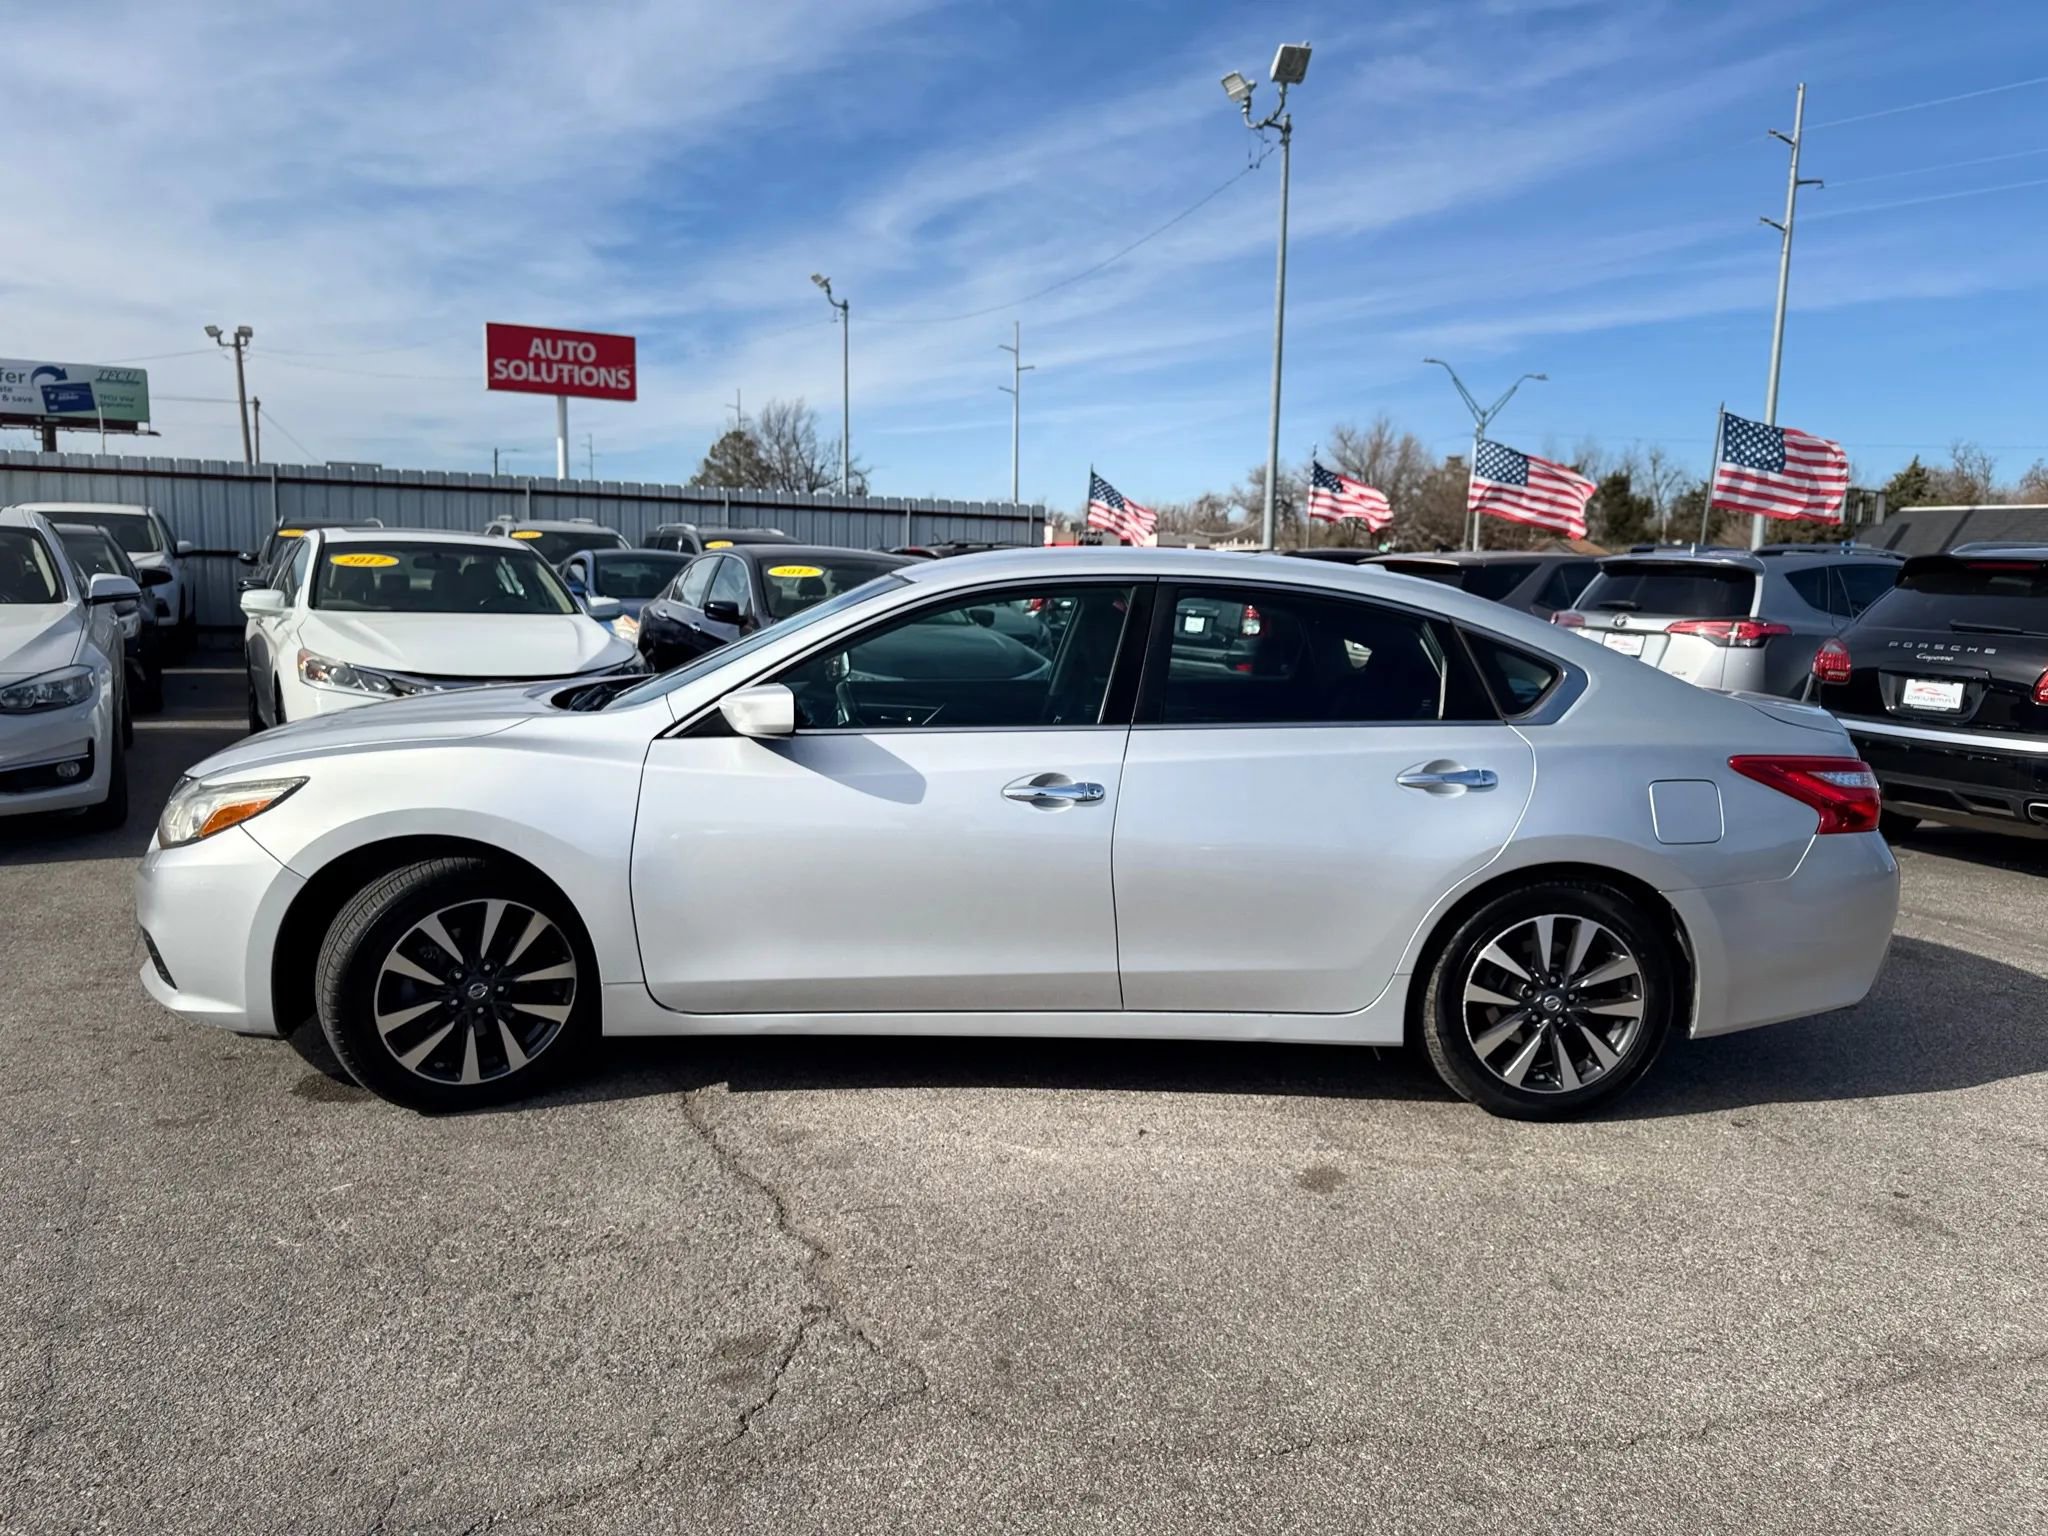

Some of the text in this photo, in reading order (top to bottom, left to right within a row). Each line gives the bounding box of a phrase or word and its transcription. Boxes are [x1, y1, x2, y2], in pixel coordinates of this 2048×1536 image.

[528, 337, 597, 363] AUTO
[493, 358, 631, 390] SOLUTIONS
[343, 556, 388, 565] 2017
[1888, 641, 1997, 655] PORSCHE
